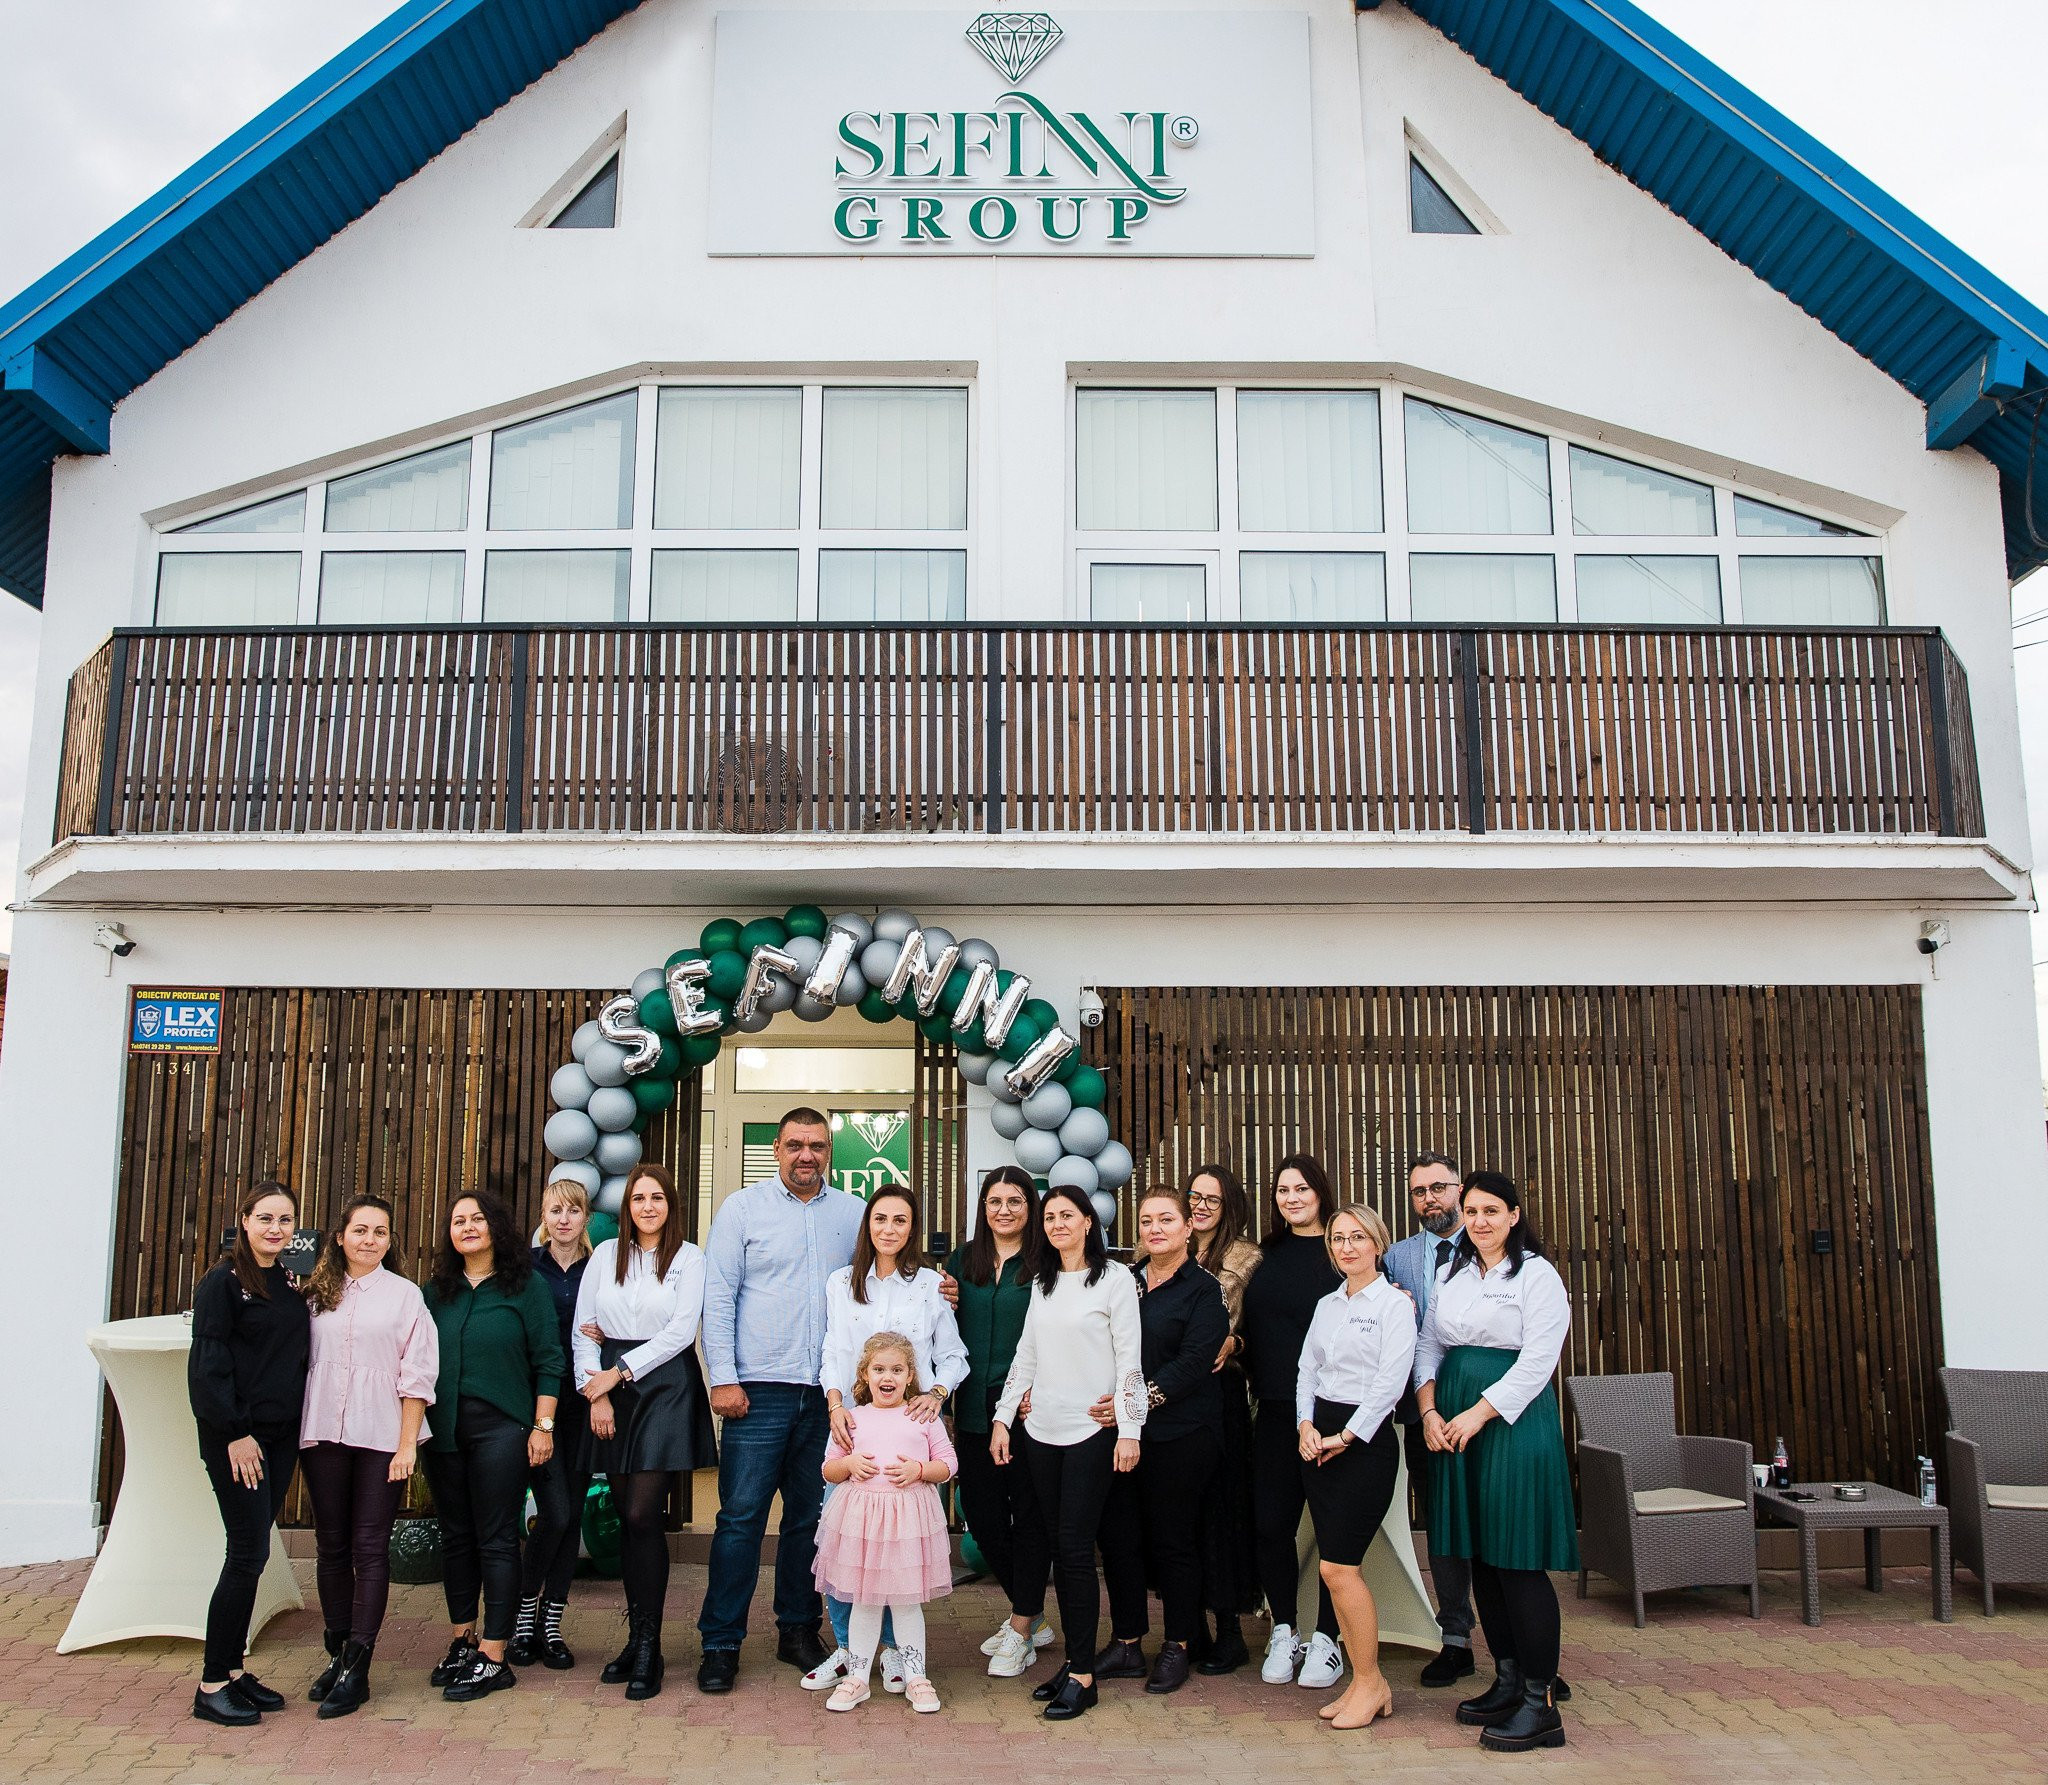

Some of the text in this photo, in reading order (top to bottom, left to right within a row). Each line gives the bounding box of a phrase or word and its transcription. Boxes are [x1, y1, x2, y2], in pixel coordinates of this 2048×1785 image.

[836, 92, 1187, 200] SEFINNI
[834, 197, 1149, 242] GROUP
[136, 991, 220, 1000] OBIECTIV PROTEJAT DE
[165, 1007, 216, 1027] LEX
[163, 1028, 215, 1037] PROTECT
